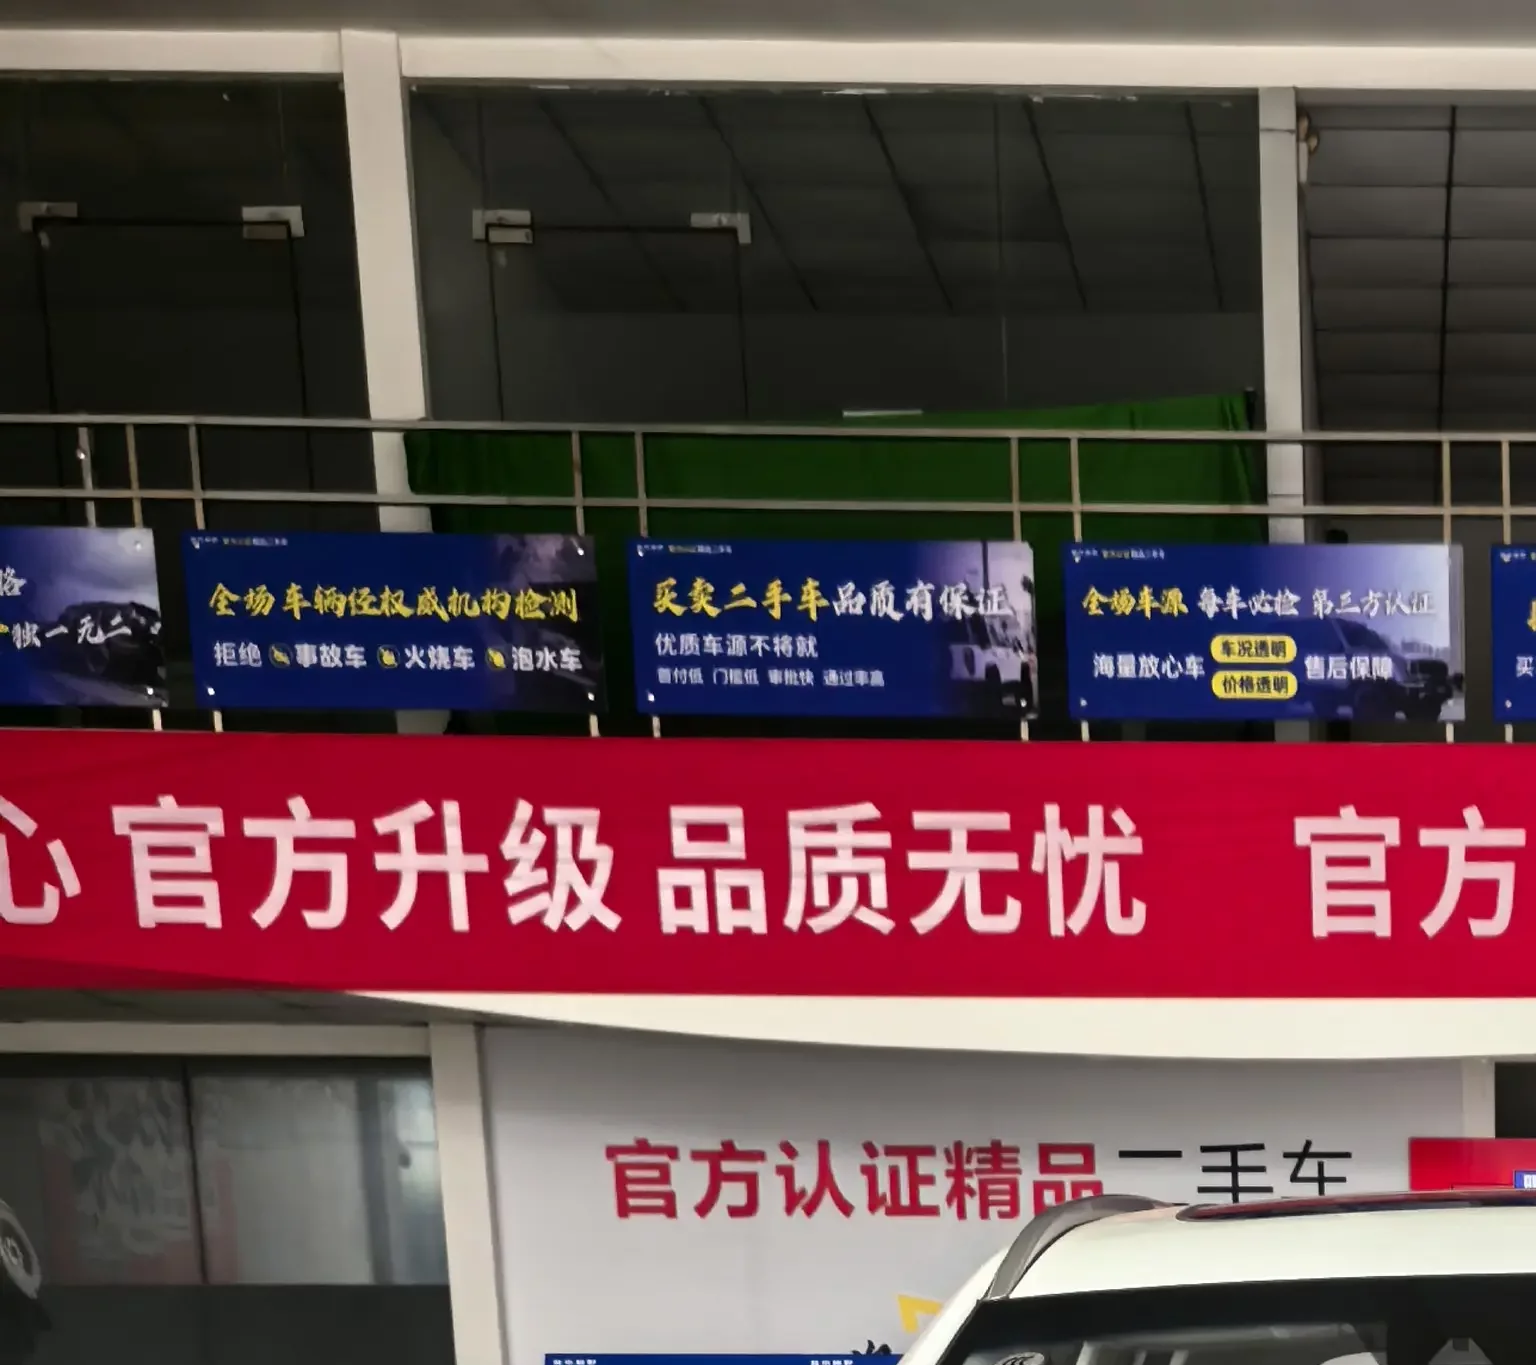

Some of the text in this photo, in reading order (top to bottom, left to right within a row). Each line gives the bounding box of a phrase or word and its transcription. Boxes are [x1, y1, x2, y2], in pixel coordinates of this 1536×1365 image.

[209, 582, 580, 622] 全场车辆经权威机构检测
[653, 576, 1013, 622] 买卖二手车品质有保证
[1312, 587, 1436, 619] 第三方认证
[0, 612, 132, 650] 独一无二
[655, 633, 819, 659] 优质车源不将就
[214, 640, 583, 672] 拒绝 事故车 火烧车 泡水车
[1221, 639, 1287, 660] 车况透明
[1093, 653, 1393, 681] 海量放心车 售后保障
[1222, 675, 1288, 695] 价格透明
[0, 798, 82, 926] 心
[112, 795, 622, 934] 官方升级
[657, 802, 1148, 938] 品质无忧
